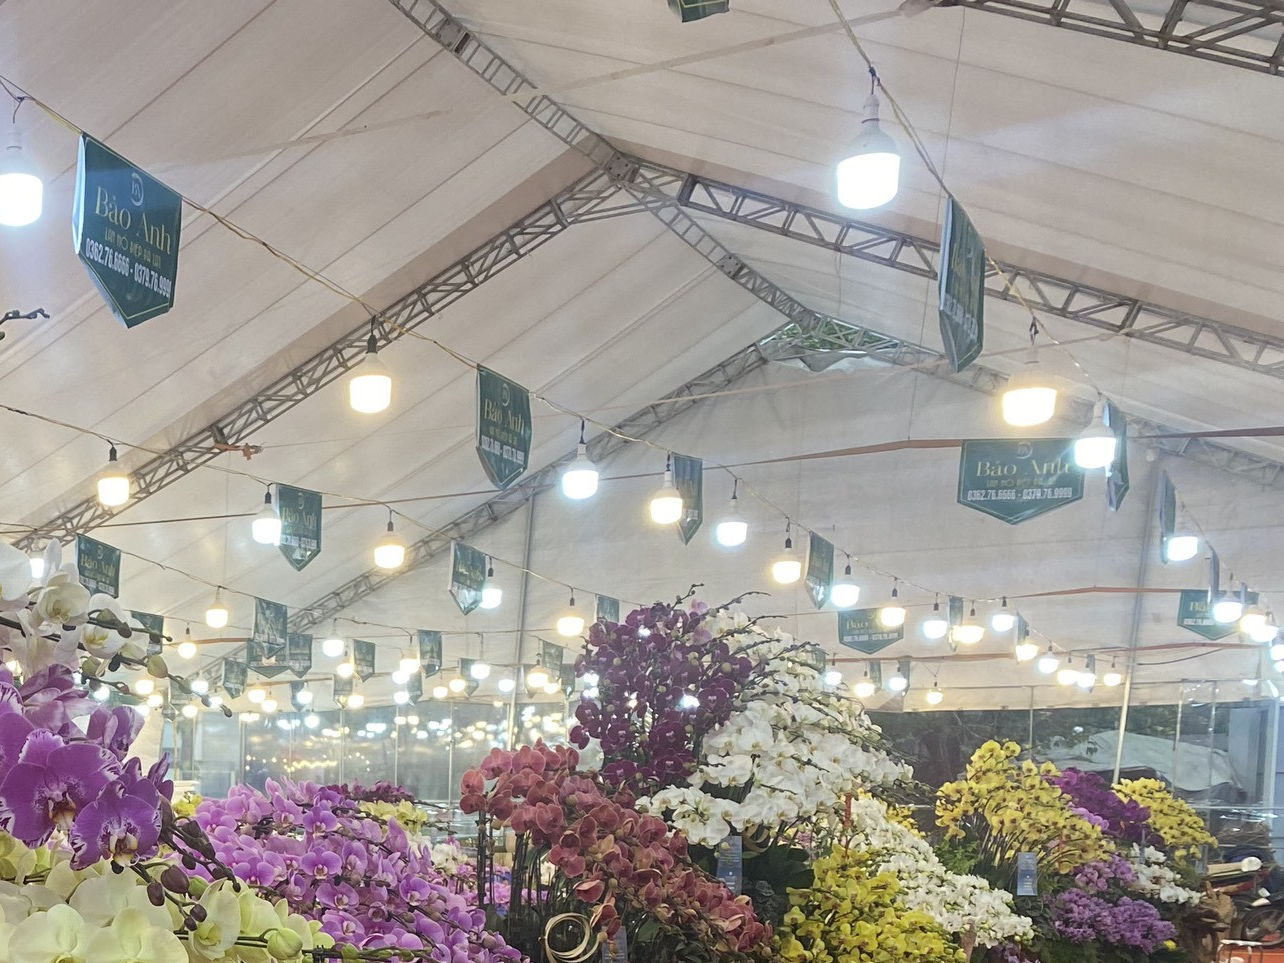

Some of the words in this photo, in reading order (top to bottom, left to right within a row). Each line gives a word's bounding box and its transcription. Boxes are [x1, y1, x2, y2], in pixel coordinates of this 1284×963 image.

[95, 186, 132, 230] Bảo
[135, 212, 172, 255] Anh
[976, 460, 1017, 477] Bảo
